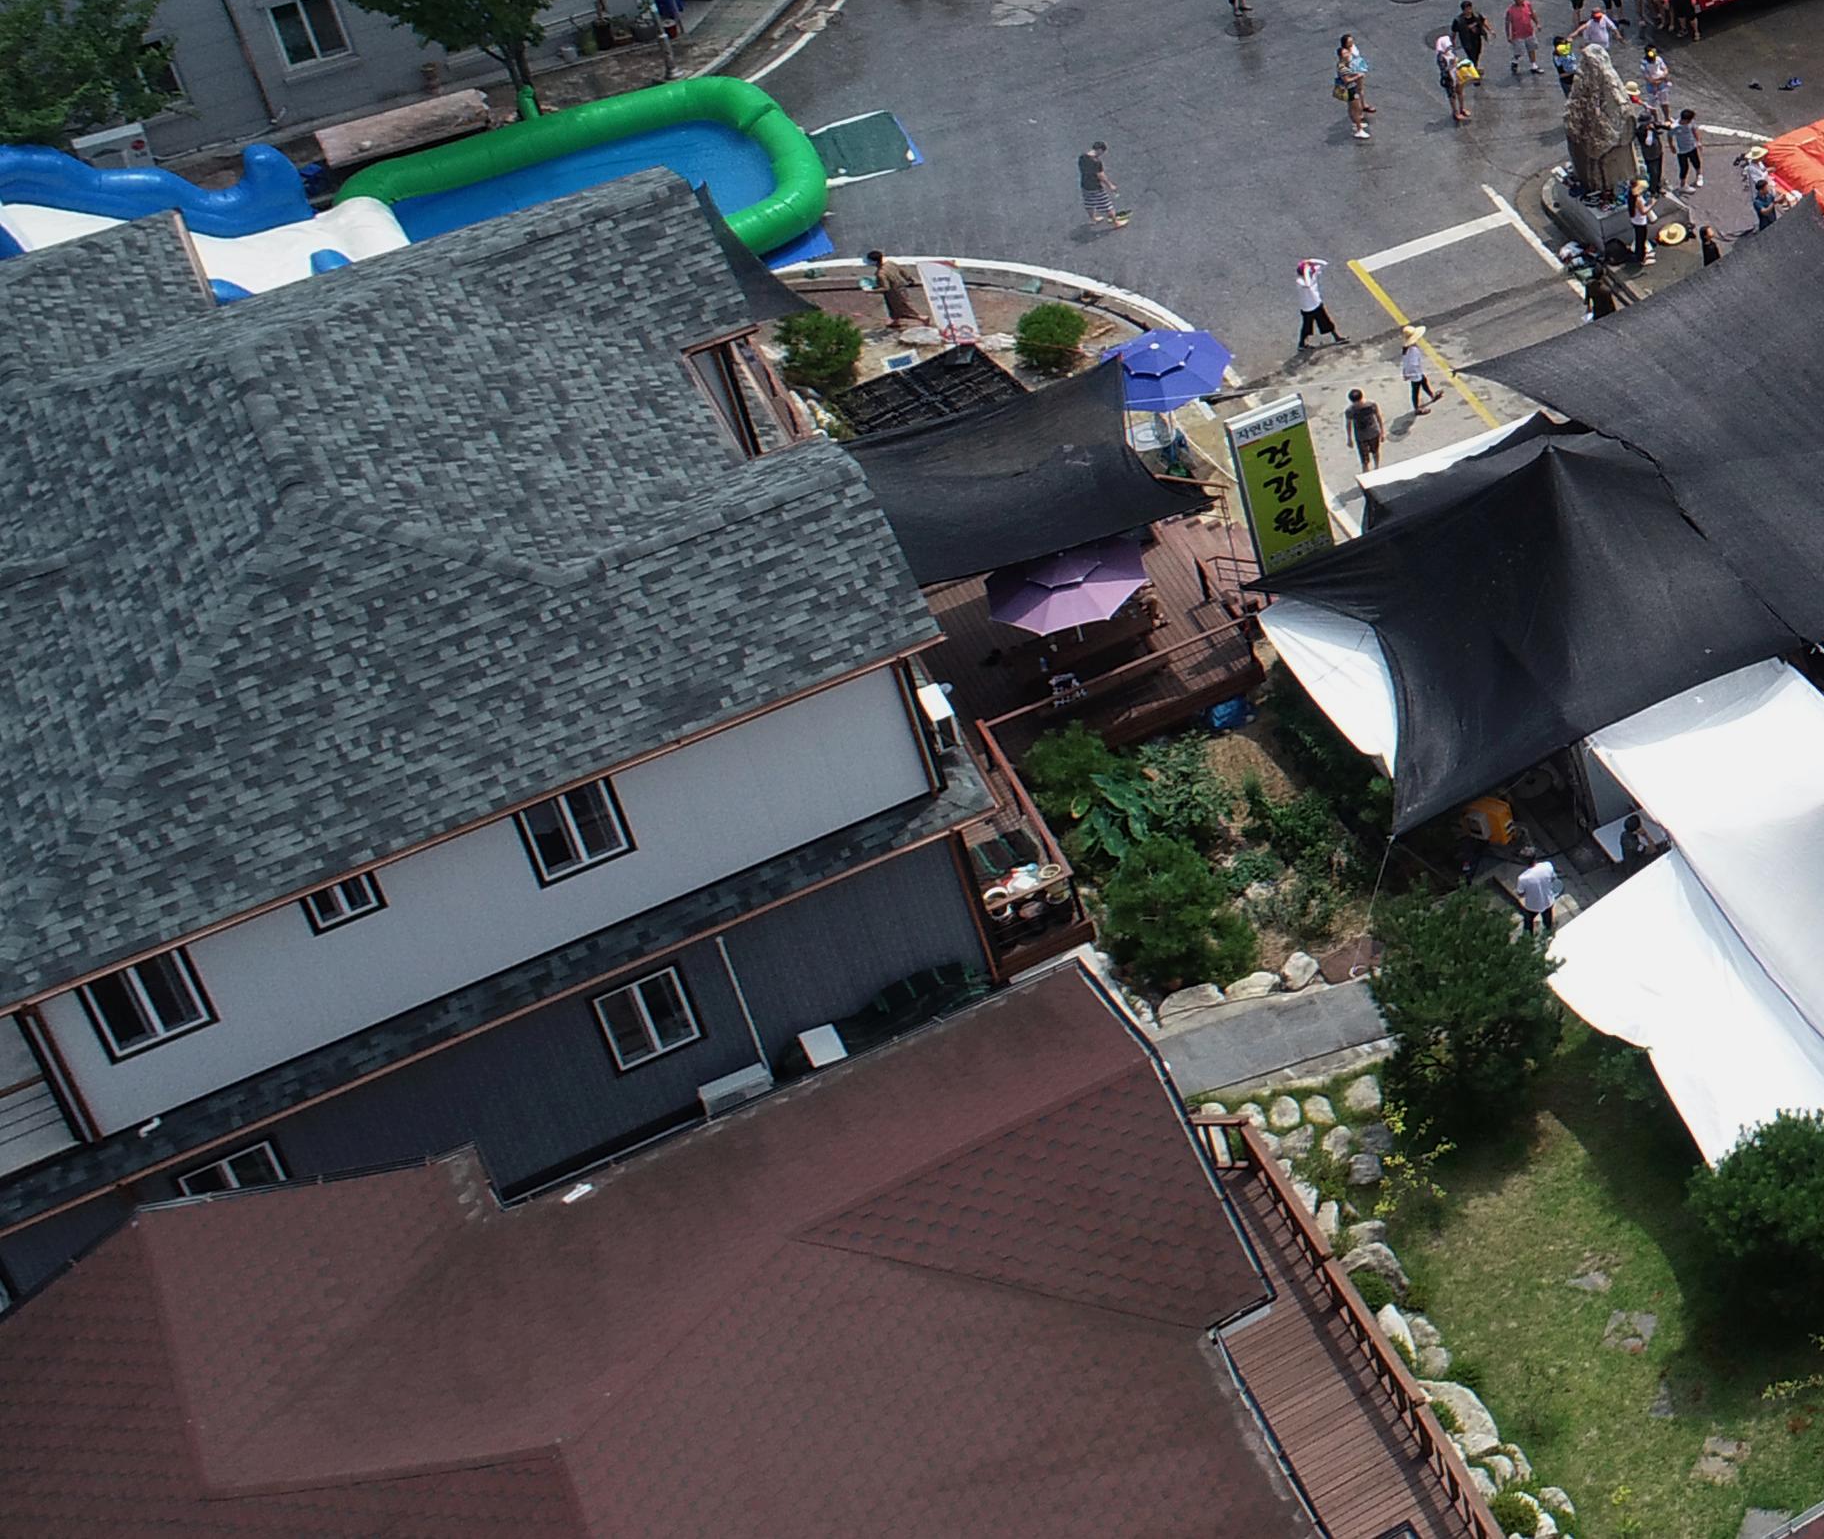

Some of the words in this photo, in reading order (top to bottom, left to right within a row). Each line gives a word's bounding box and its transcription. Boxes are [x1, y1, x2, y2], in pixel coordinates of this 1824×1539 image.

[1237, 421, 1272, 440] 자연산
[1276, 410, 1301, 424] 약초
[1256, 439, 1309, 535] 건강원
